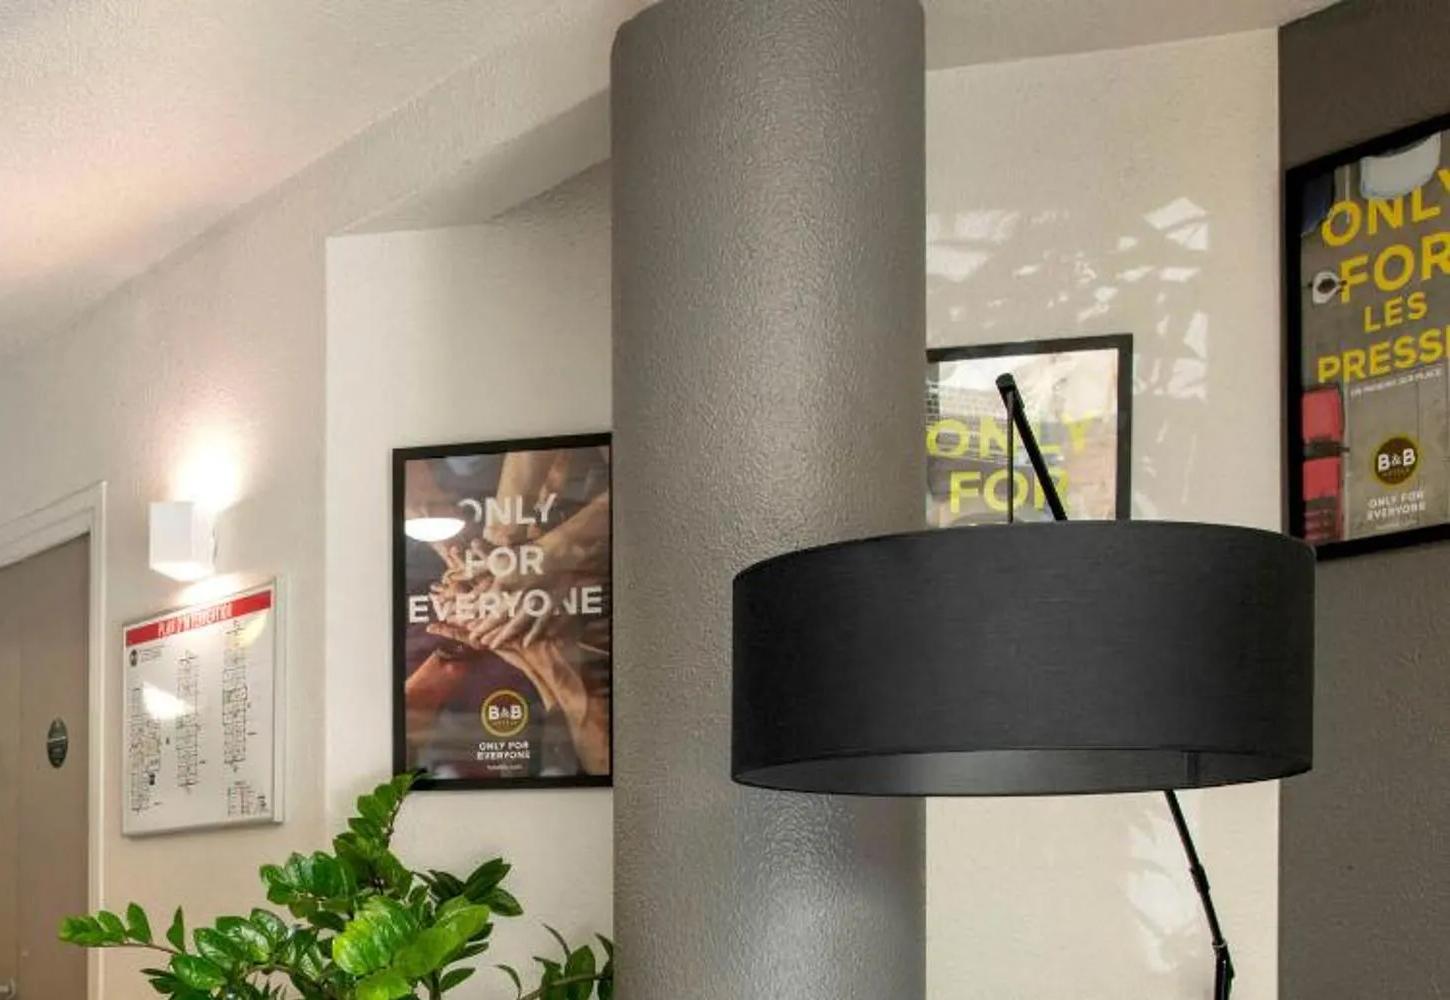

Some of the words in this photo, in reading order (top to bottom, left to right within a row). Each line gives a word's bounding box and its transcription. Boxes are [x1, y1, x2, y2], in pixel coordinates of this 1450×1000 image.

[1340, 232, 1450, 304] FOR
[1364, 291, 1428, 332] LES
[1318, 324, 1450, 384] PRESS
[926, 410, 1094, 460] ONLY
[1377, 448, 1416, 473] B&B
[950, 466, 1071, 514] FOR
[464, 545, 545, 579] FOR
[408, 586, 603, 624] EVERYONE
[488, 705, 523, 720] B&B
[476, 750, 531, 760] EVERYONE
[478, 741, 506, 751] ONLY
